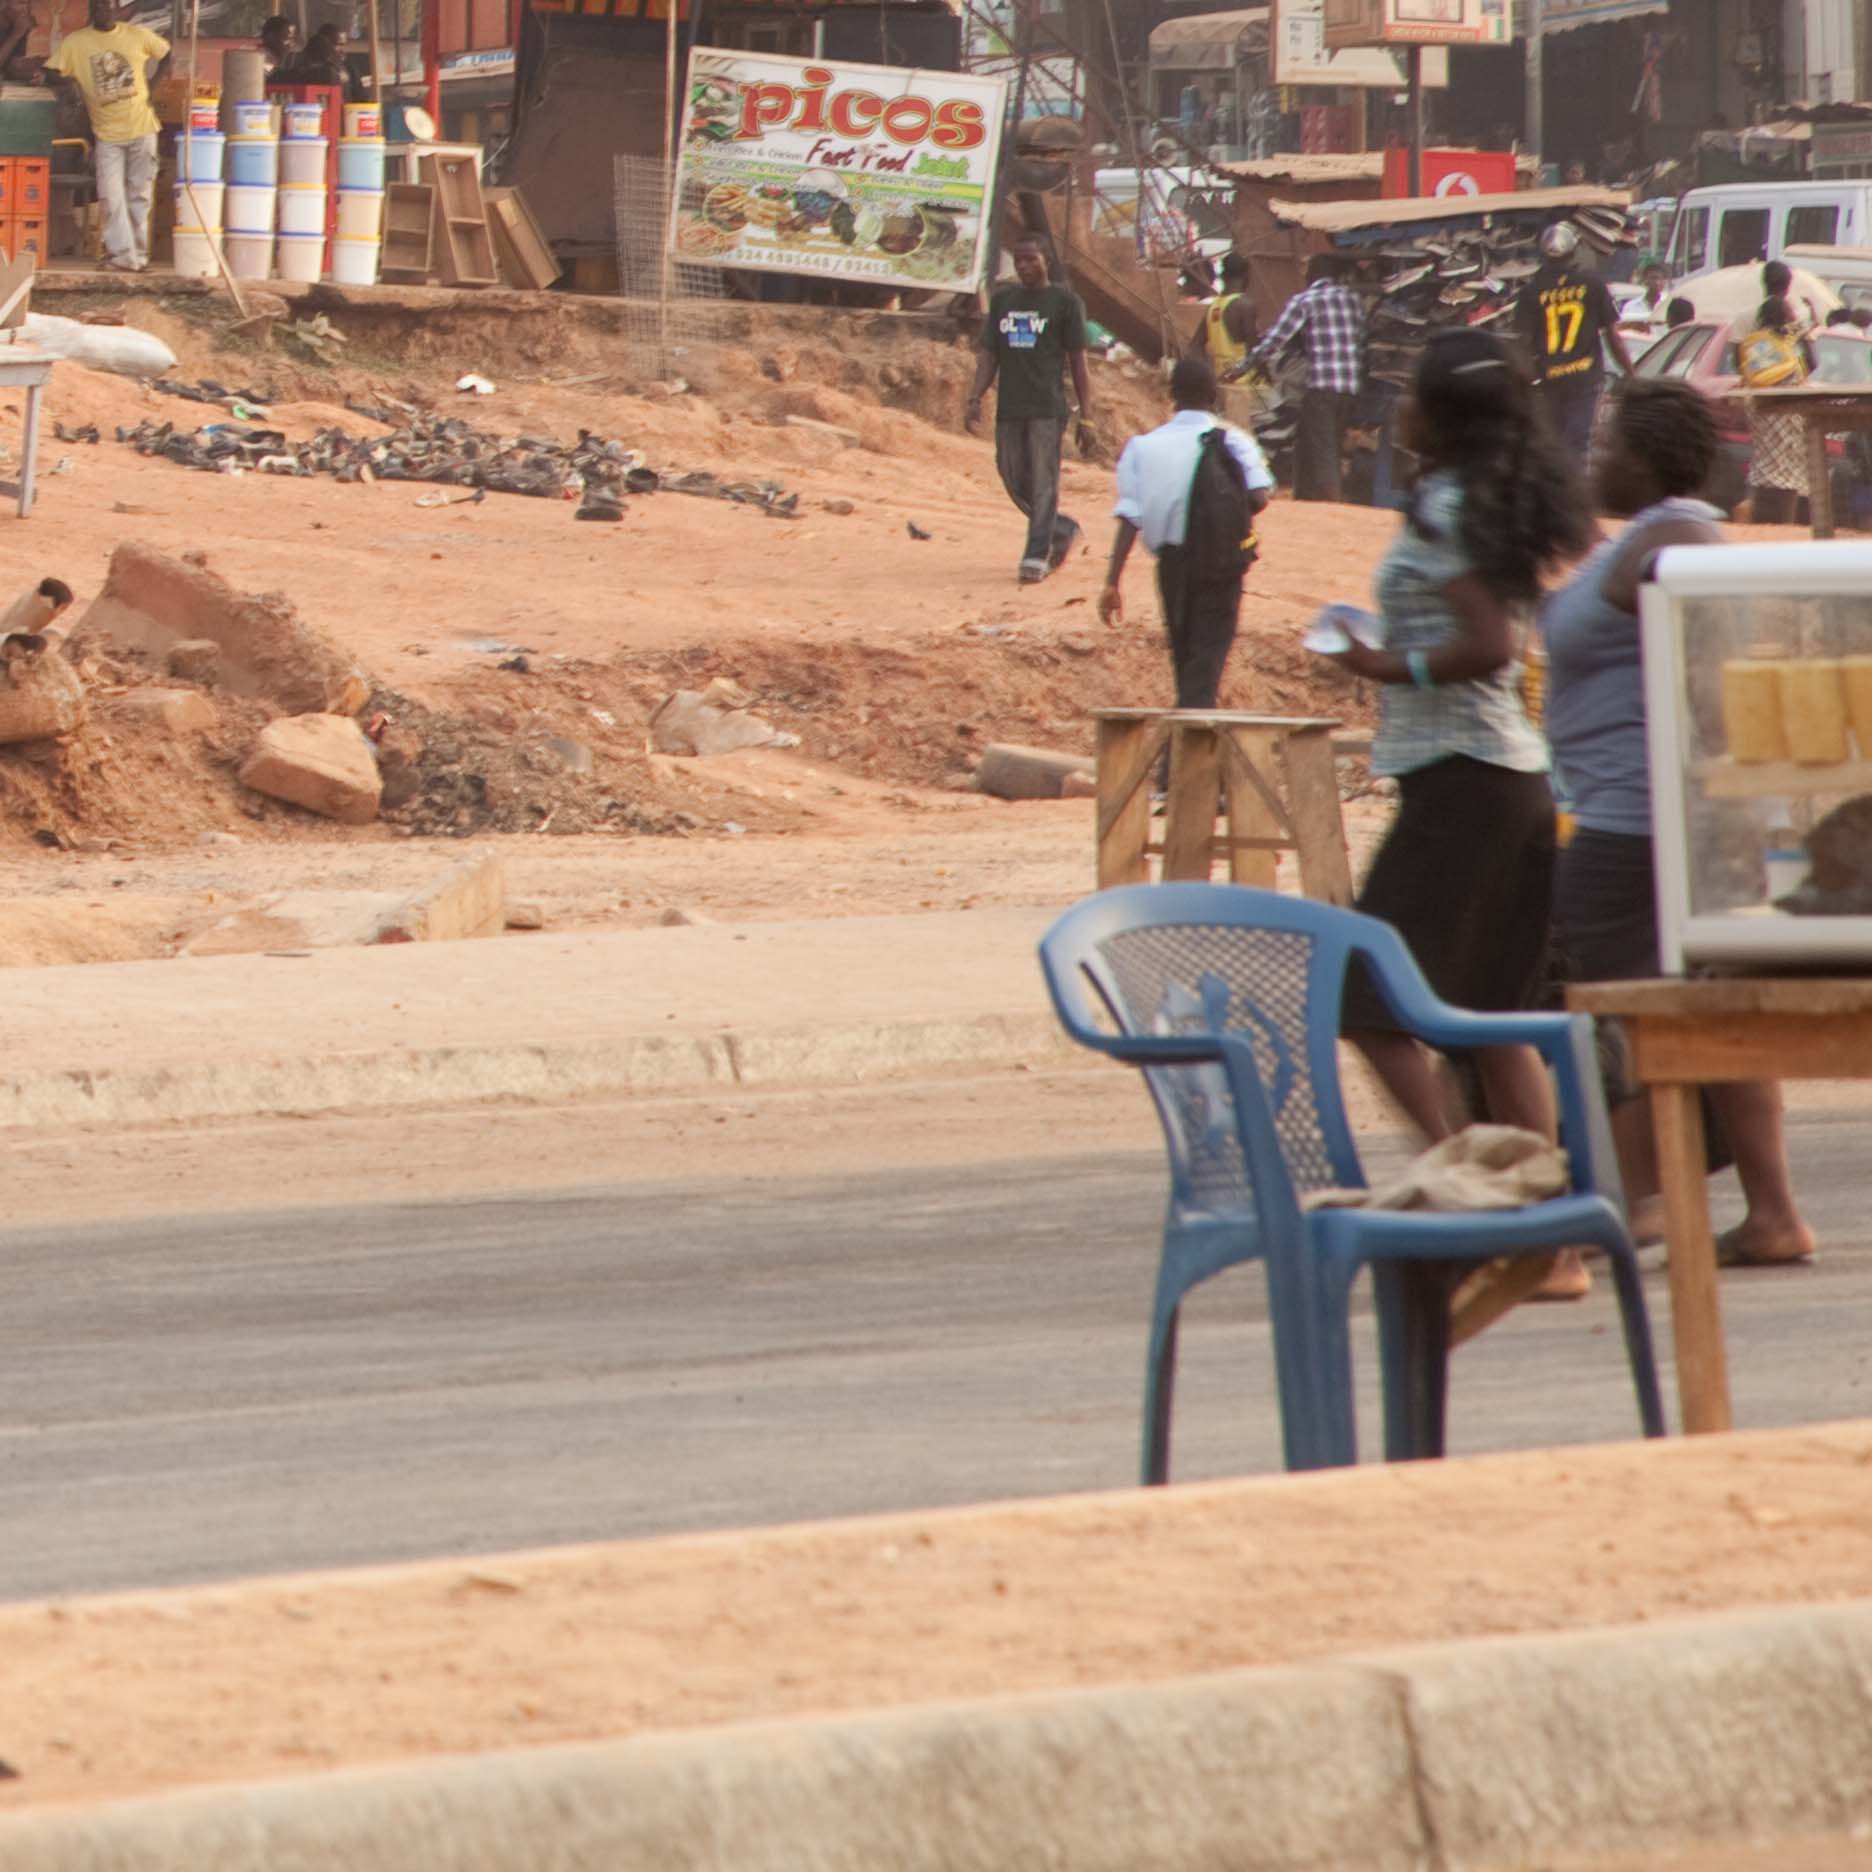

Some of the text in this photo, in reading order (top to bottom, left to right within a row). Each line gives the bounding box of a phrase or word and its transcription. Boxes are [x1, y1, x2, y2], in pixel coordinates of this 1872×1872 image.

[732, 66, 986, 151] picos
[999, 317, 1048, 335] GLW
[1545, 301, 1585, 355] 17
